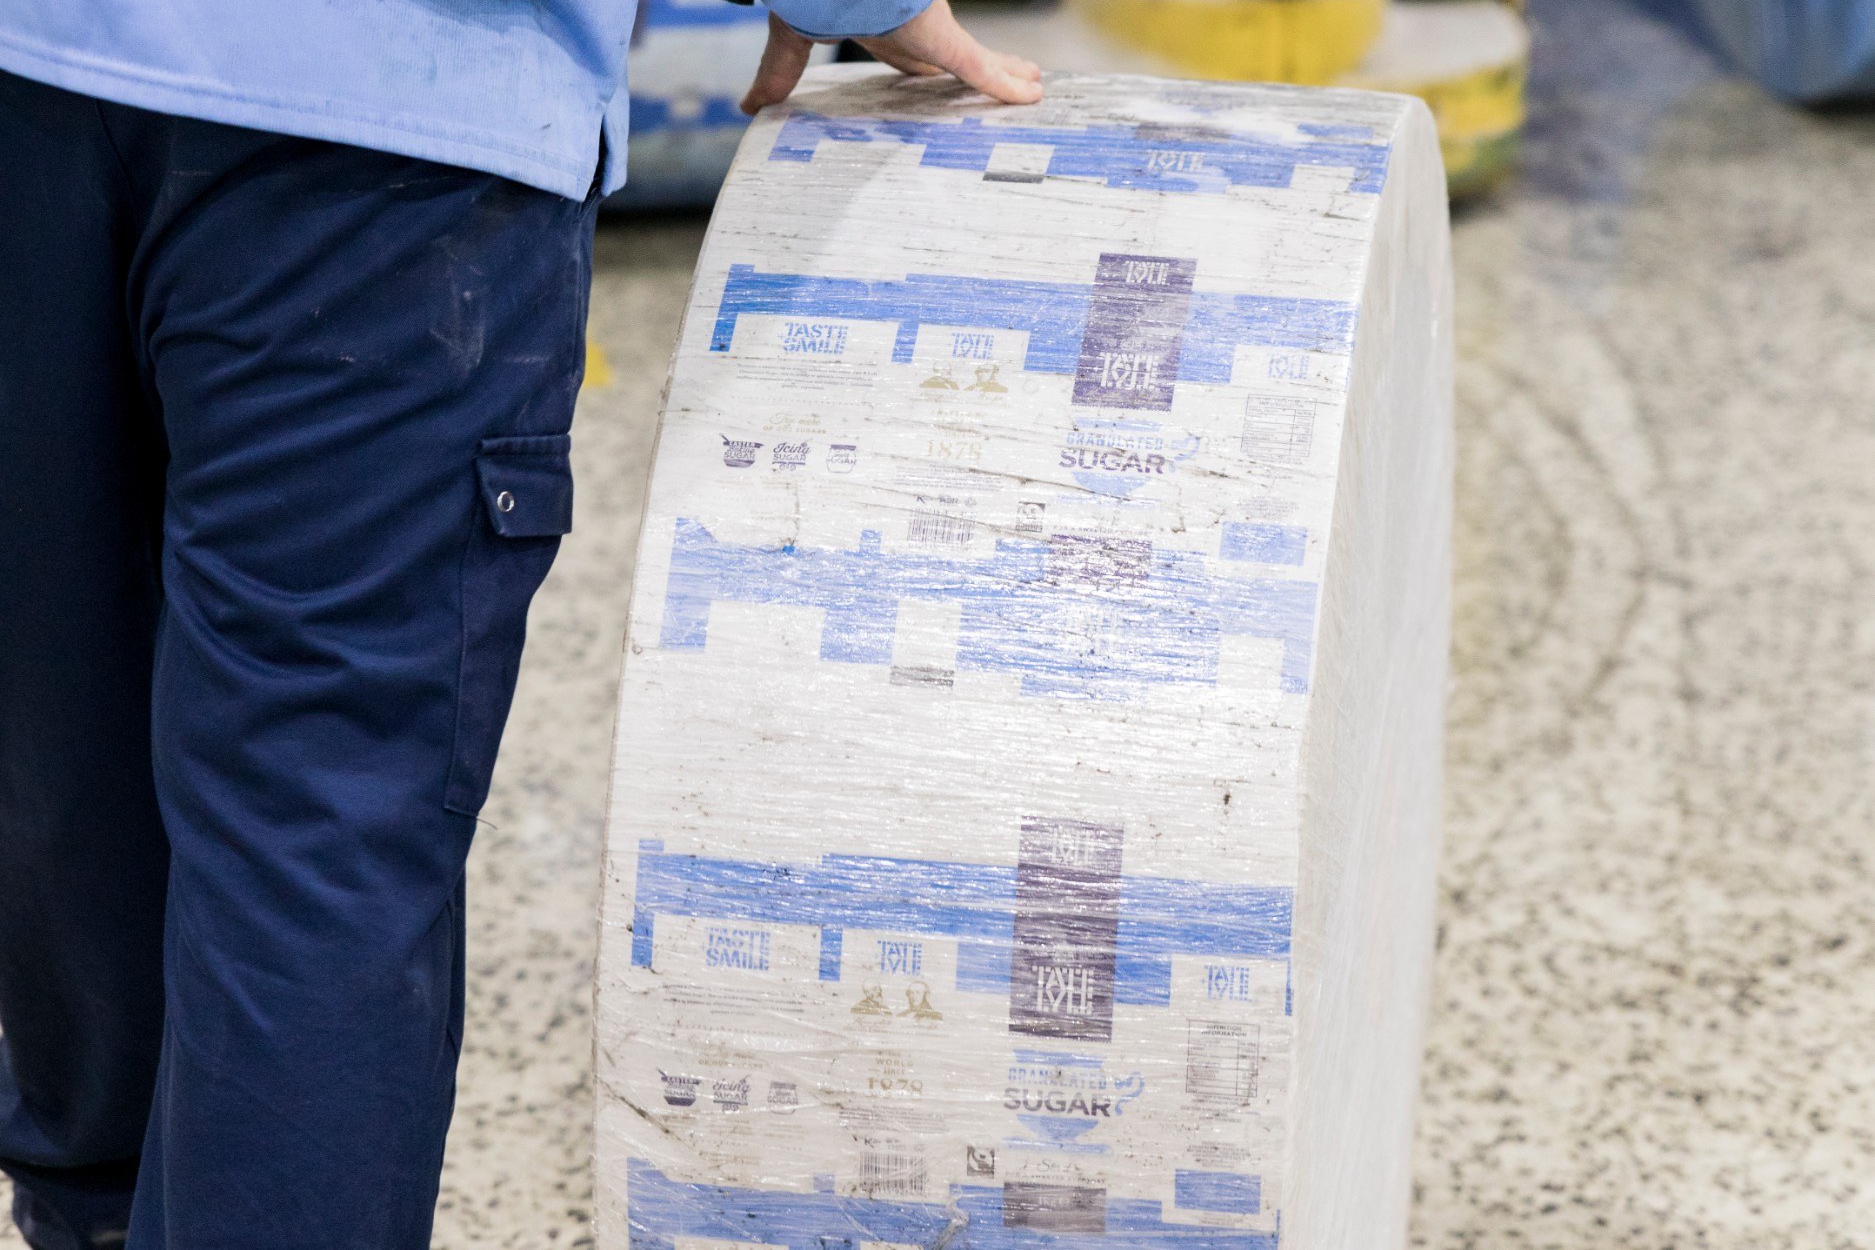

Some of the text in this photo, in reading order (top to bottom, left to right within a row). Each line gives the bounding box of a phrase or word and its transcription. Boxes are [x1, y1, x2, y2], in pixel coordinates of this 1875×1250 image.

[784, 321, 848, 340] TASTE
[782, 337, 846, 355] SMILE
[773, 442, 811, 454] Icing
[773, 453, 806, 461] SUGAR
[1059, 447, 1166, 474] SUGAR
[705, 947, 769, 971] SMILE
[1003, 1087, 1111, 1117] SUGAR
